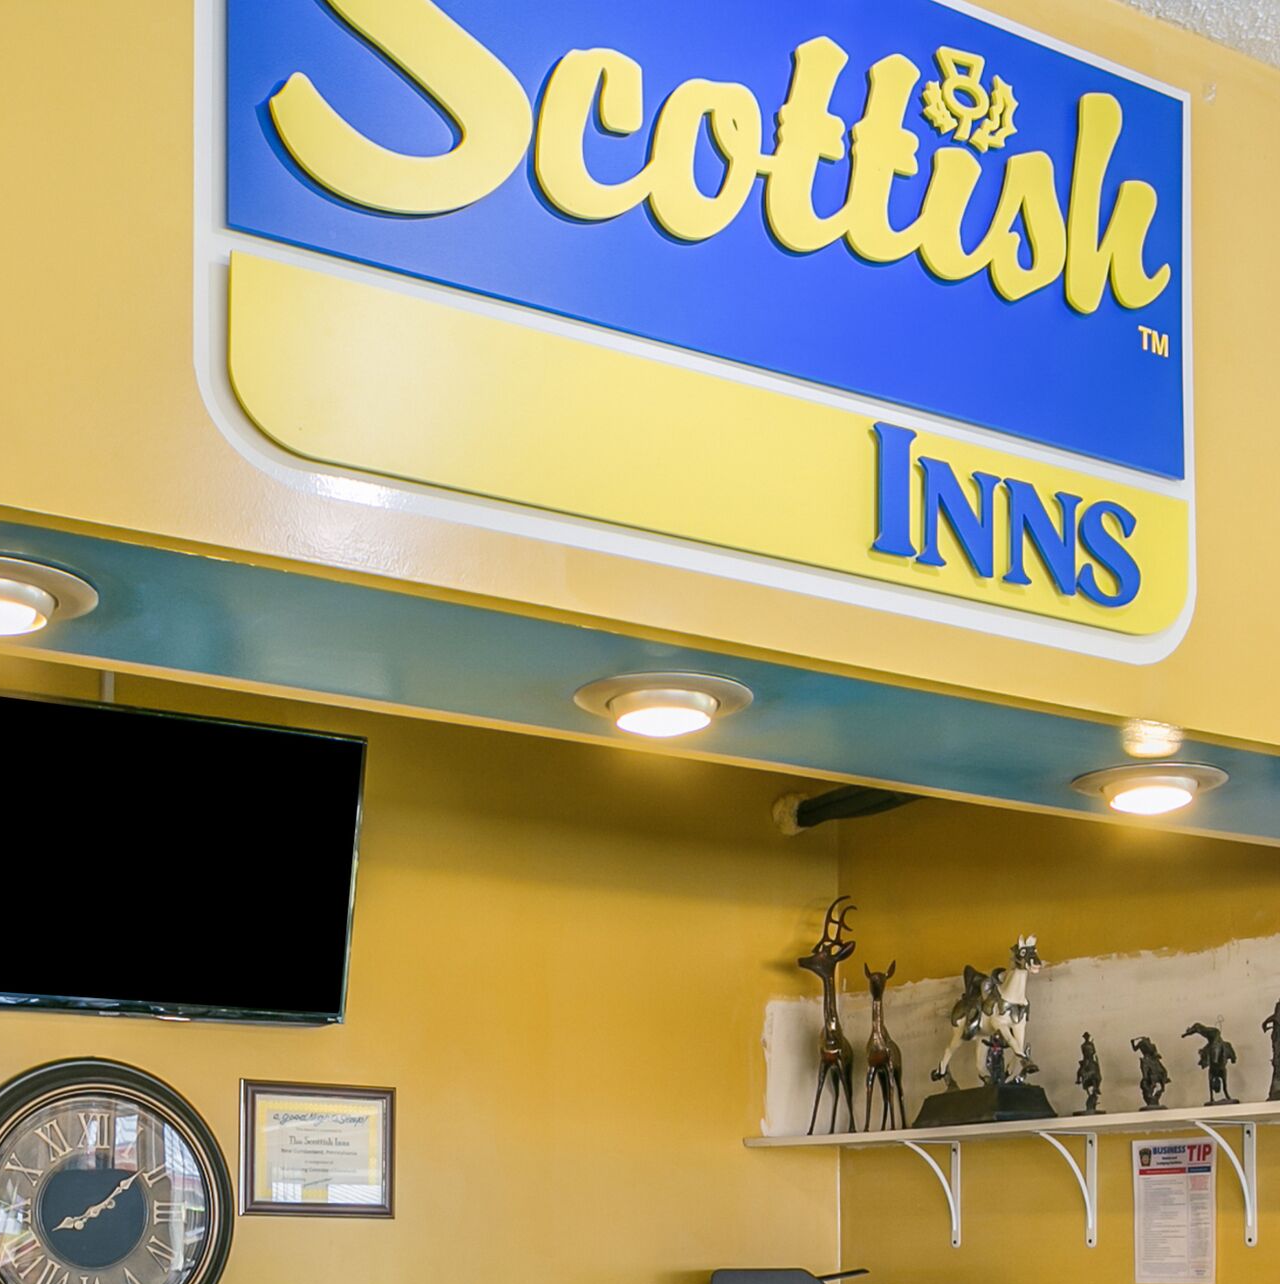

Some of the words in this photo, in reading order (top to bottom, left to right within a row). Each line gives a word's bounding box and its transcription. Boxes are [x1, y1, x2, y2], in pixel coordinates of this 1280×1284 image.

[268, 0, 1171, 315] Scottish
[871, 421, 1142, 609] INNS
[1187, 1143, 1212, 1161] TIP
